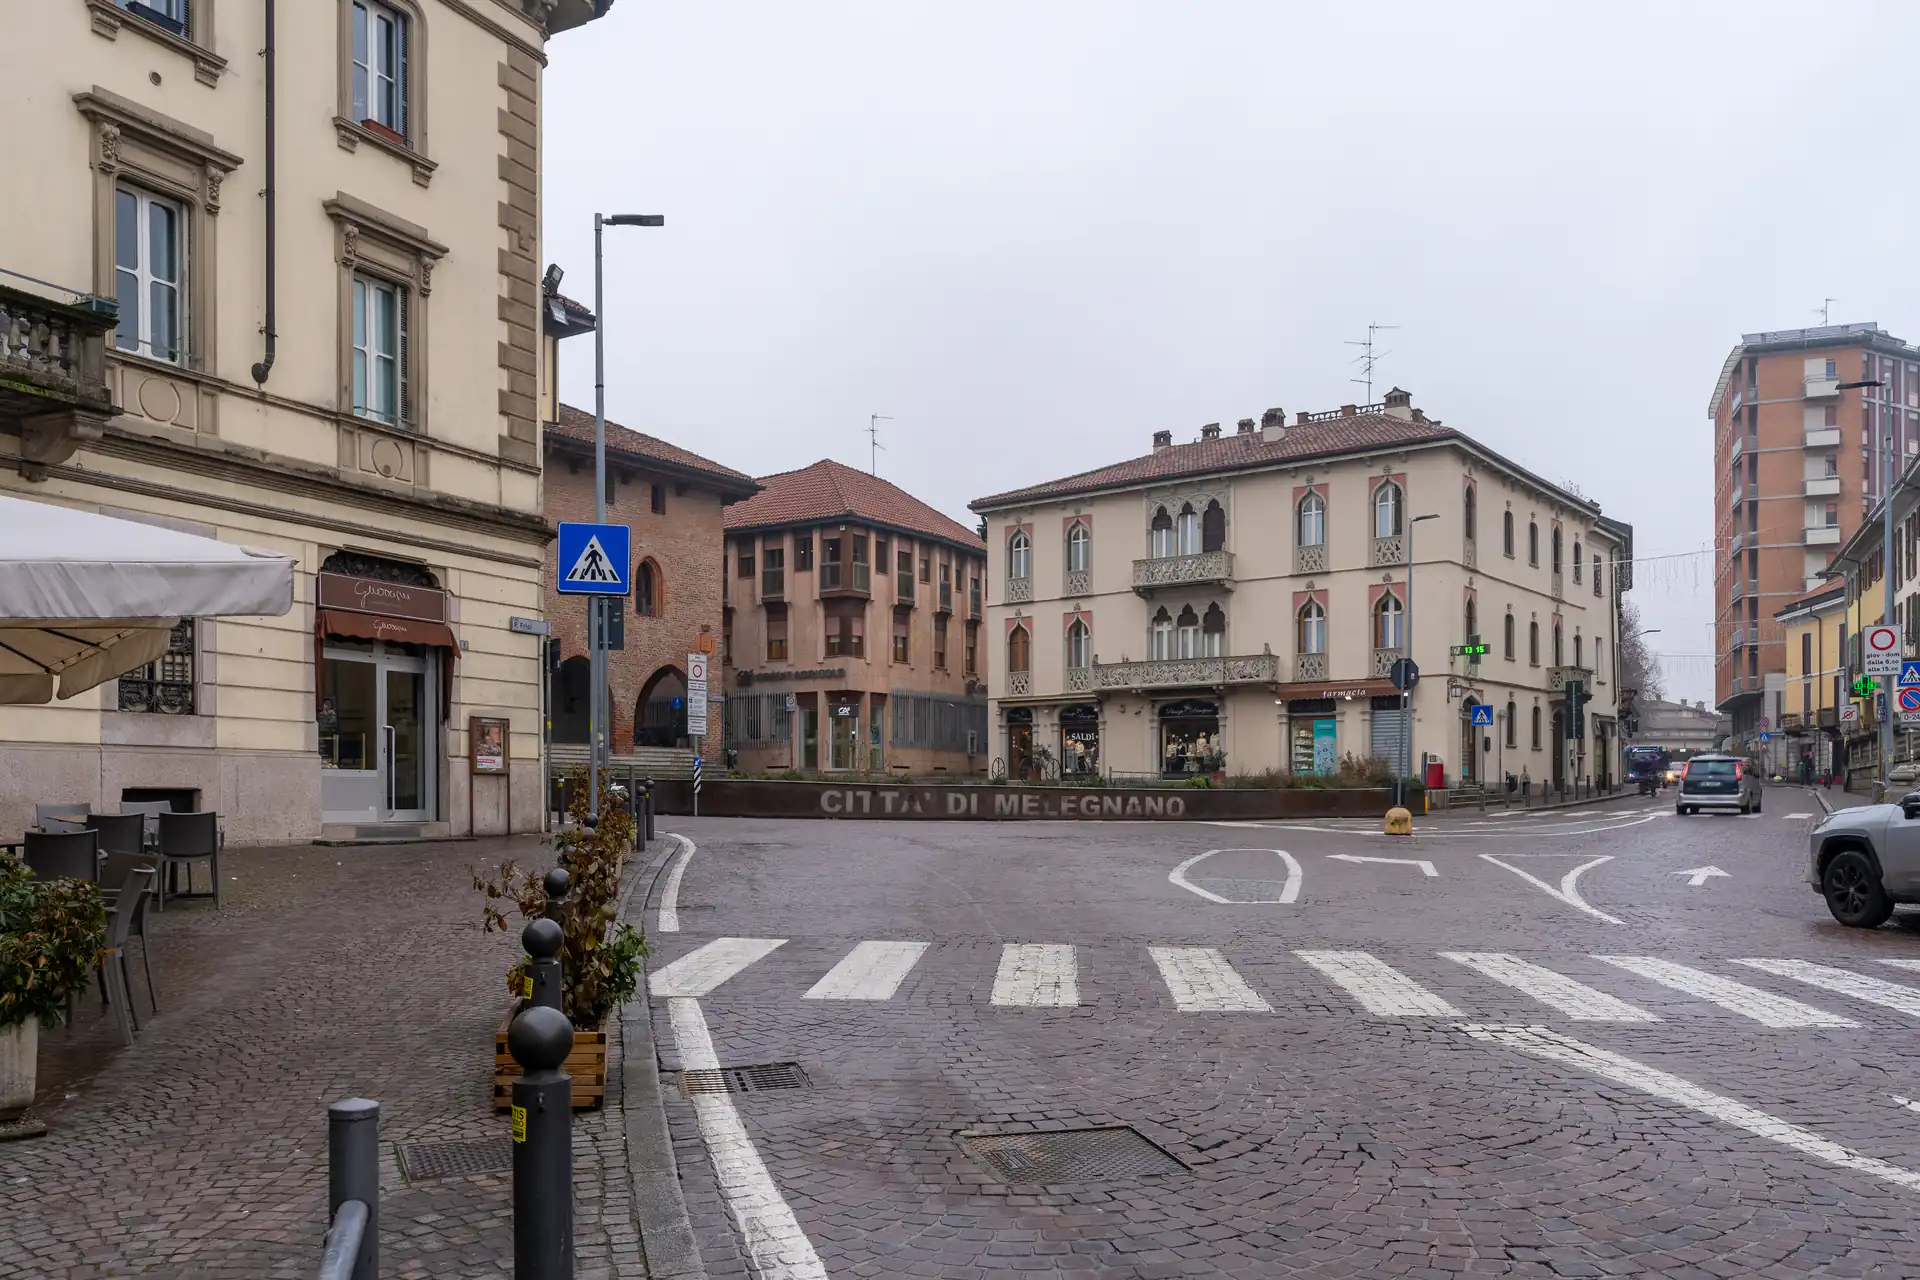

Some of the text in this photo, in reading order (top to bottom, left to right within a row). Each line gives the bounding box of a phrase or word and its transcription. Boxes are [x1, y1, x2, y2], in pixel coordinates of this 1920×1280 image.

[1465, 645, 1484, 654] 13 15
[1322, 688, 1366, 698] farmacia
[1071, 732, 1095, 741] SALDI
[946, 792, 979, 815] DI
[994, 793, 1186, 817] MELEGNANO
